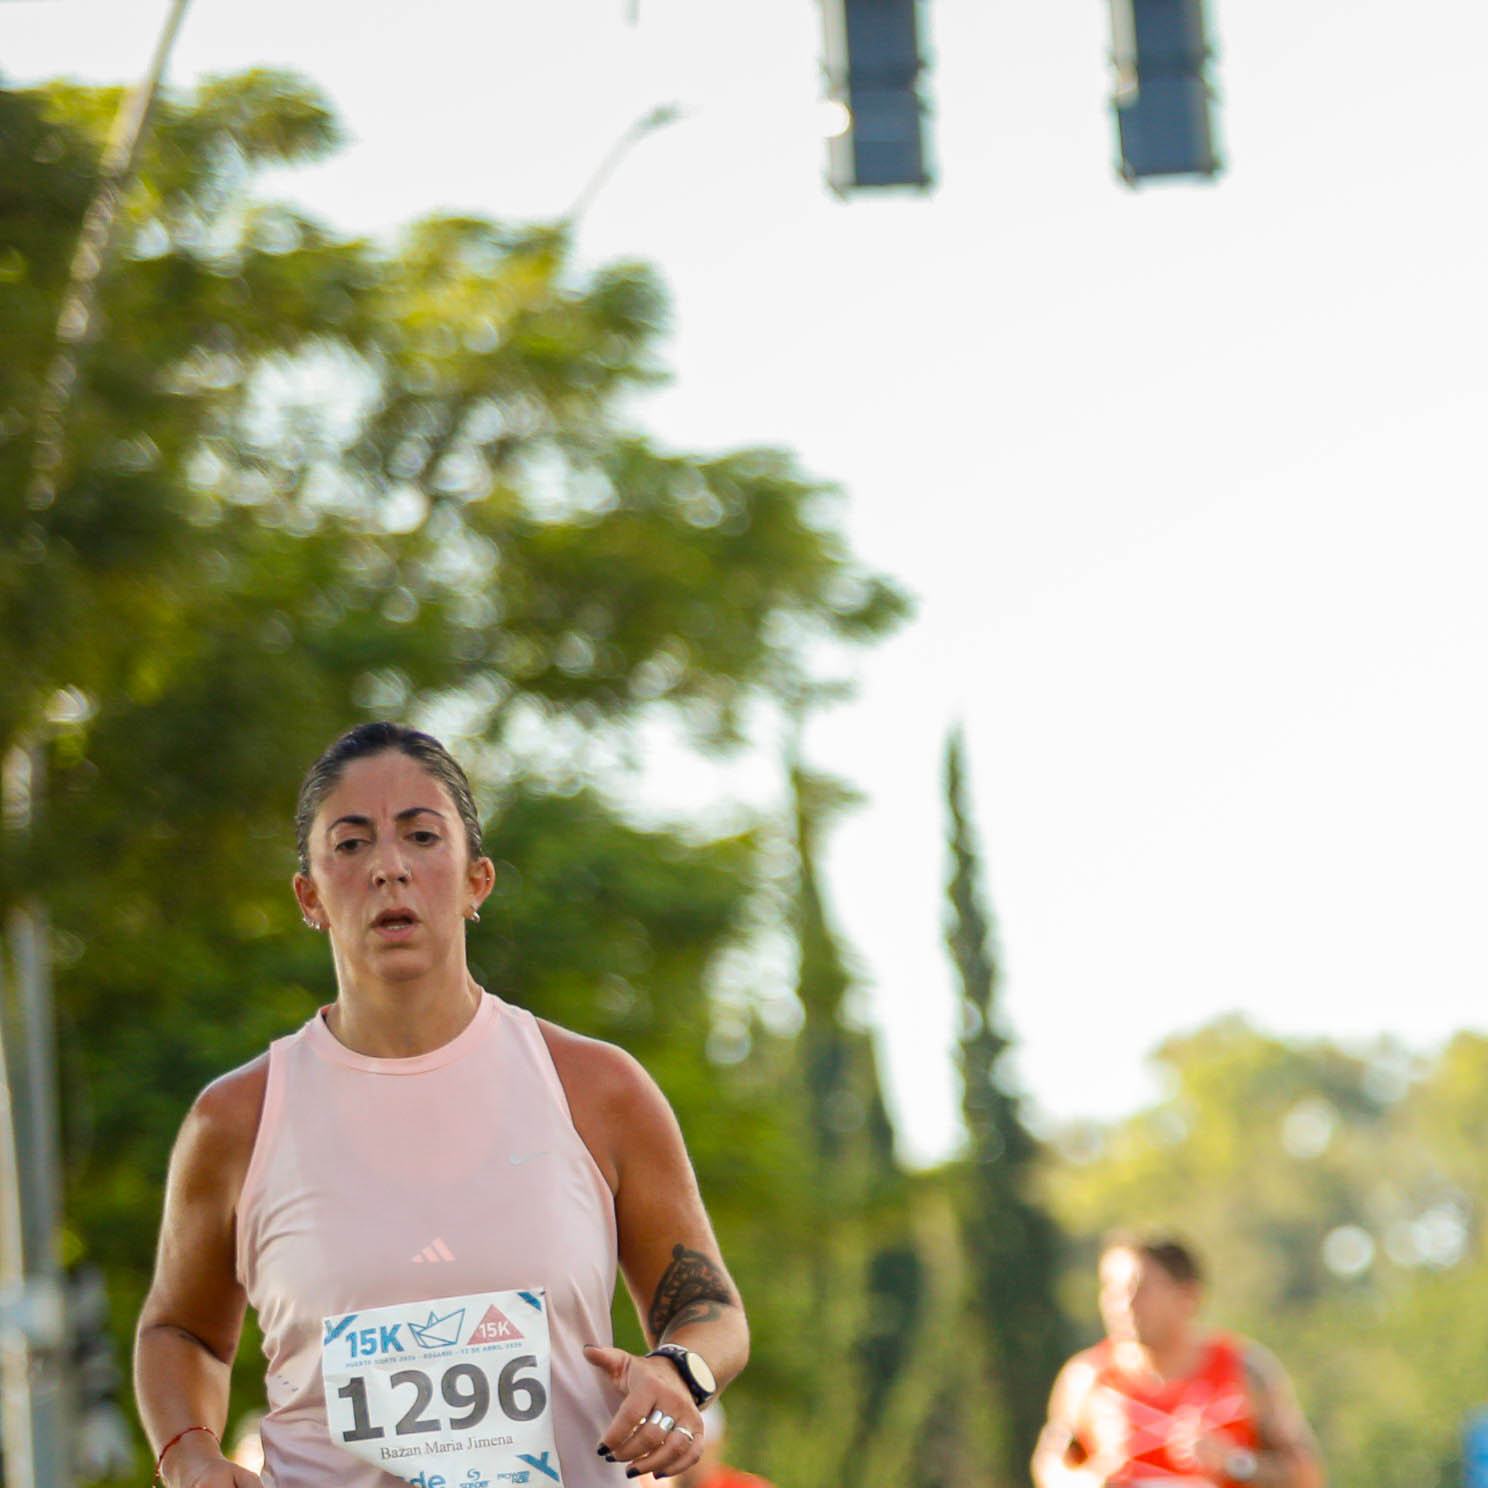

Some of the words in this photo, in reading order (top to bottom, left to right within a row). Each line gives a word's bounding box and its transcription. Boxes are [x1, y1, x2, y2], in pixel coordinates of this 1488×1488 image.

[345, 1323, 405, 1358] 15K
[479, 1321, 511, 1338] 15K
[337, 1355, 547, 1442] 1296
[380, 1447, 422, 1460] Bazan
[425, 1440, 463, 1455] Maria
[467, 1434, 514, 1450] Jimena
